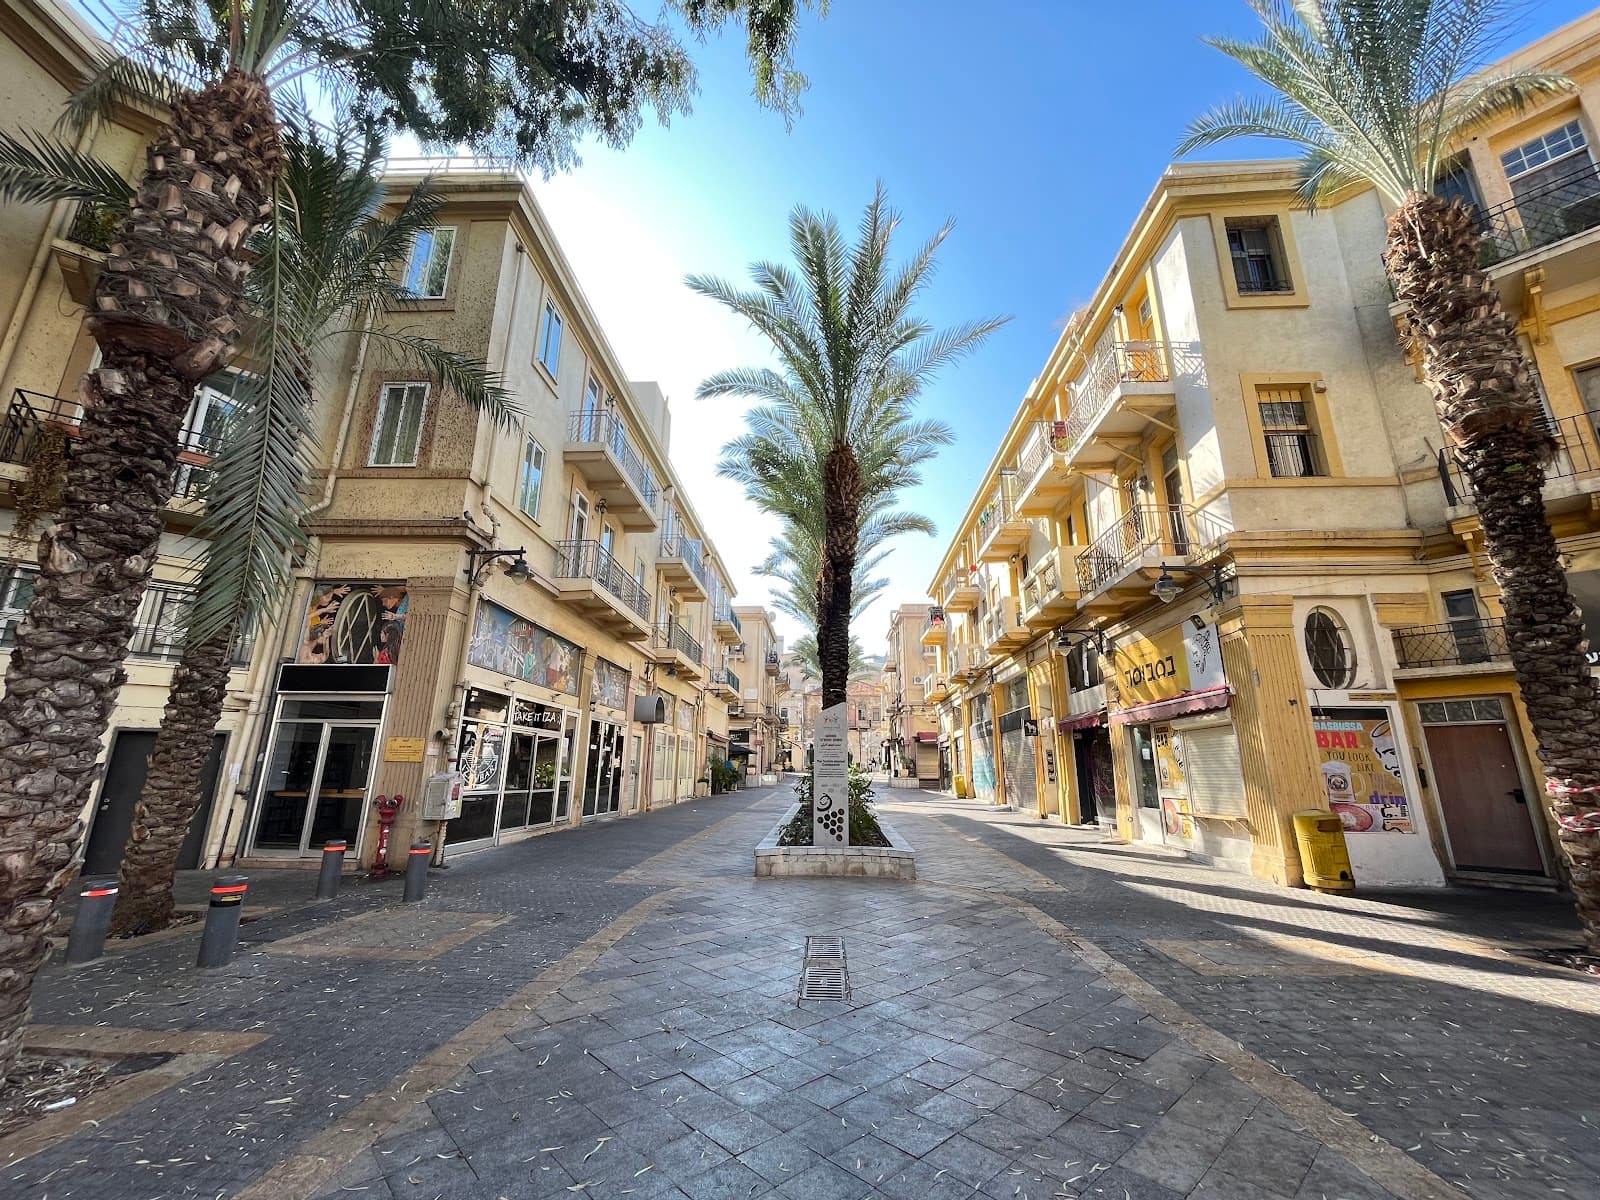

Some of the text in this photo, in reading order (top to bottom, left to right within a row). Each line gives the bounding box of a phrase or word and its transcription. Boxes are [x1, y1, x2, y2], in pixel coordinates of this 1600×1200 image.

[514, 711, 534, 722] TAKE
[1315, 731, 1358, 748] BAR
[1326, 751, 1371, 762] YOU LOOK
